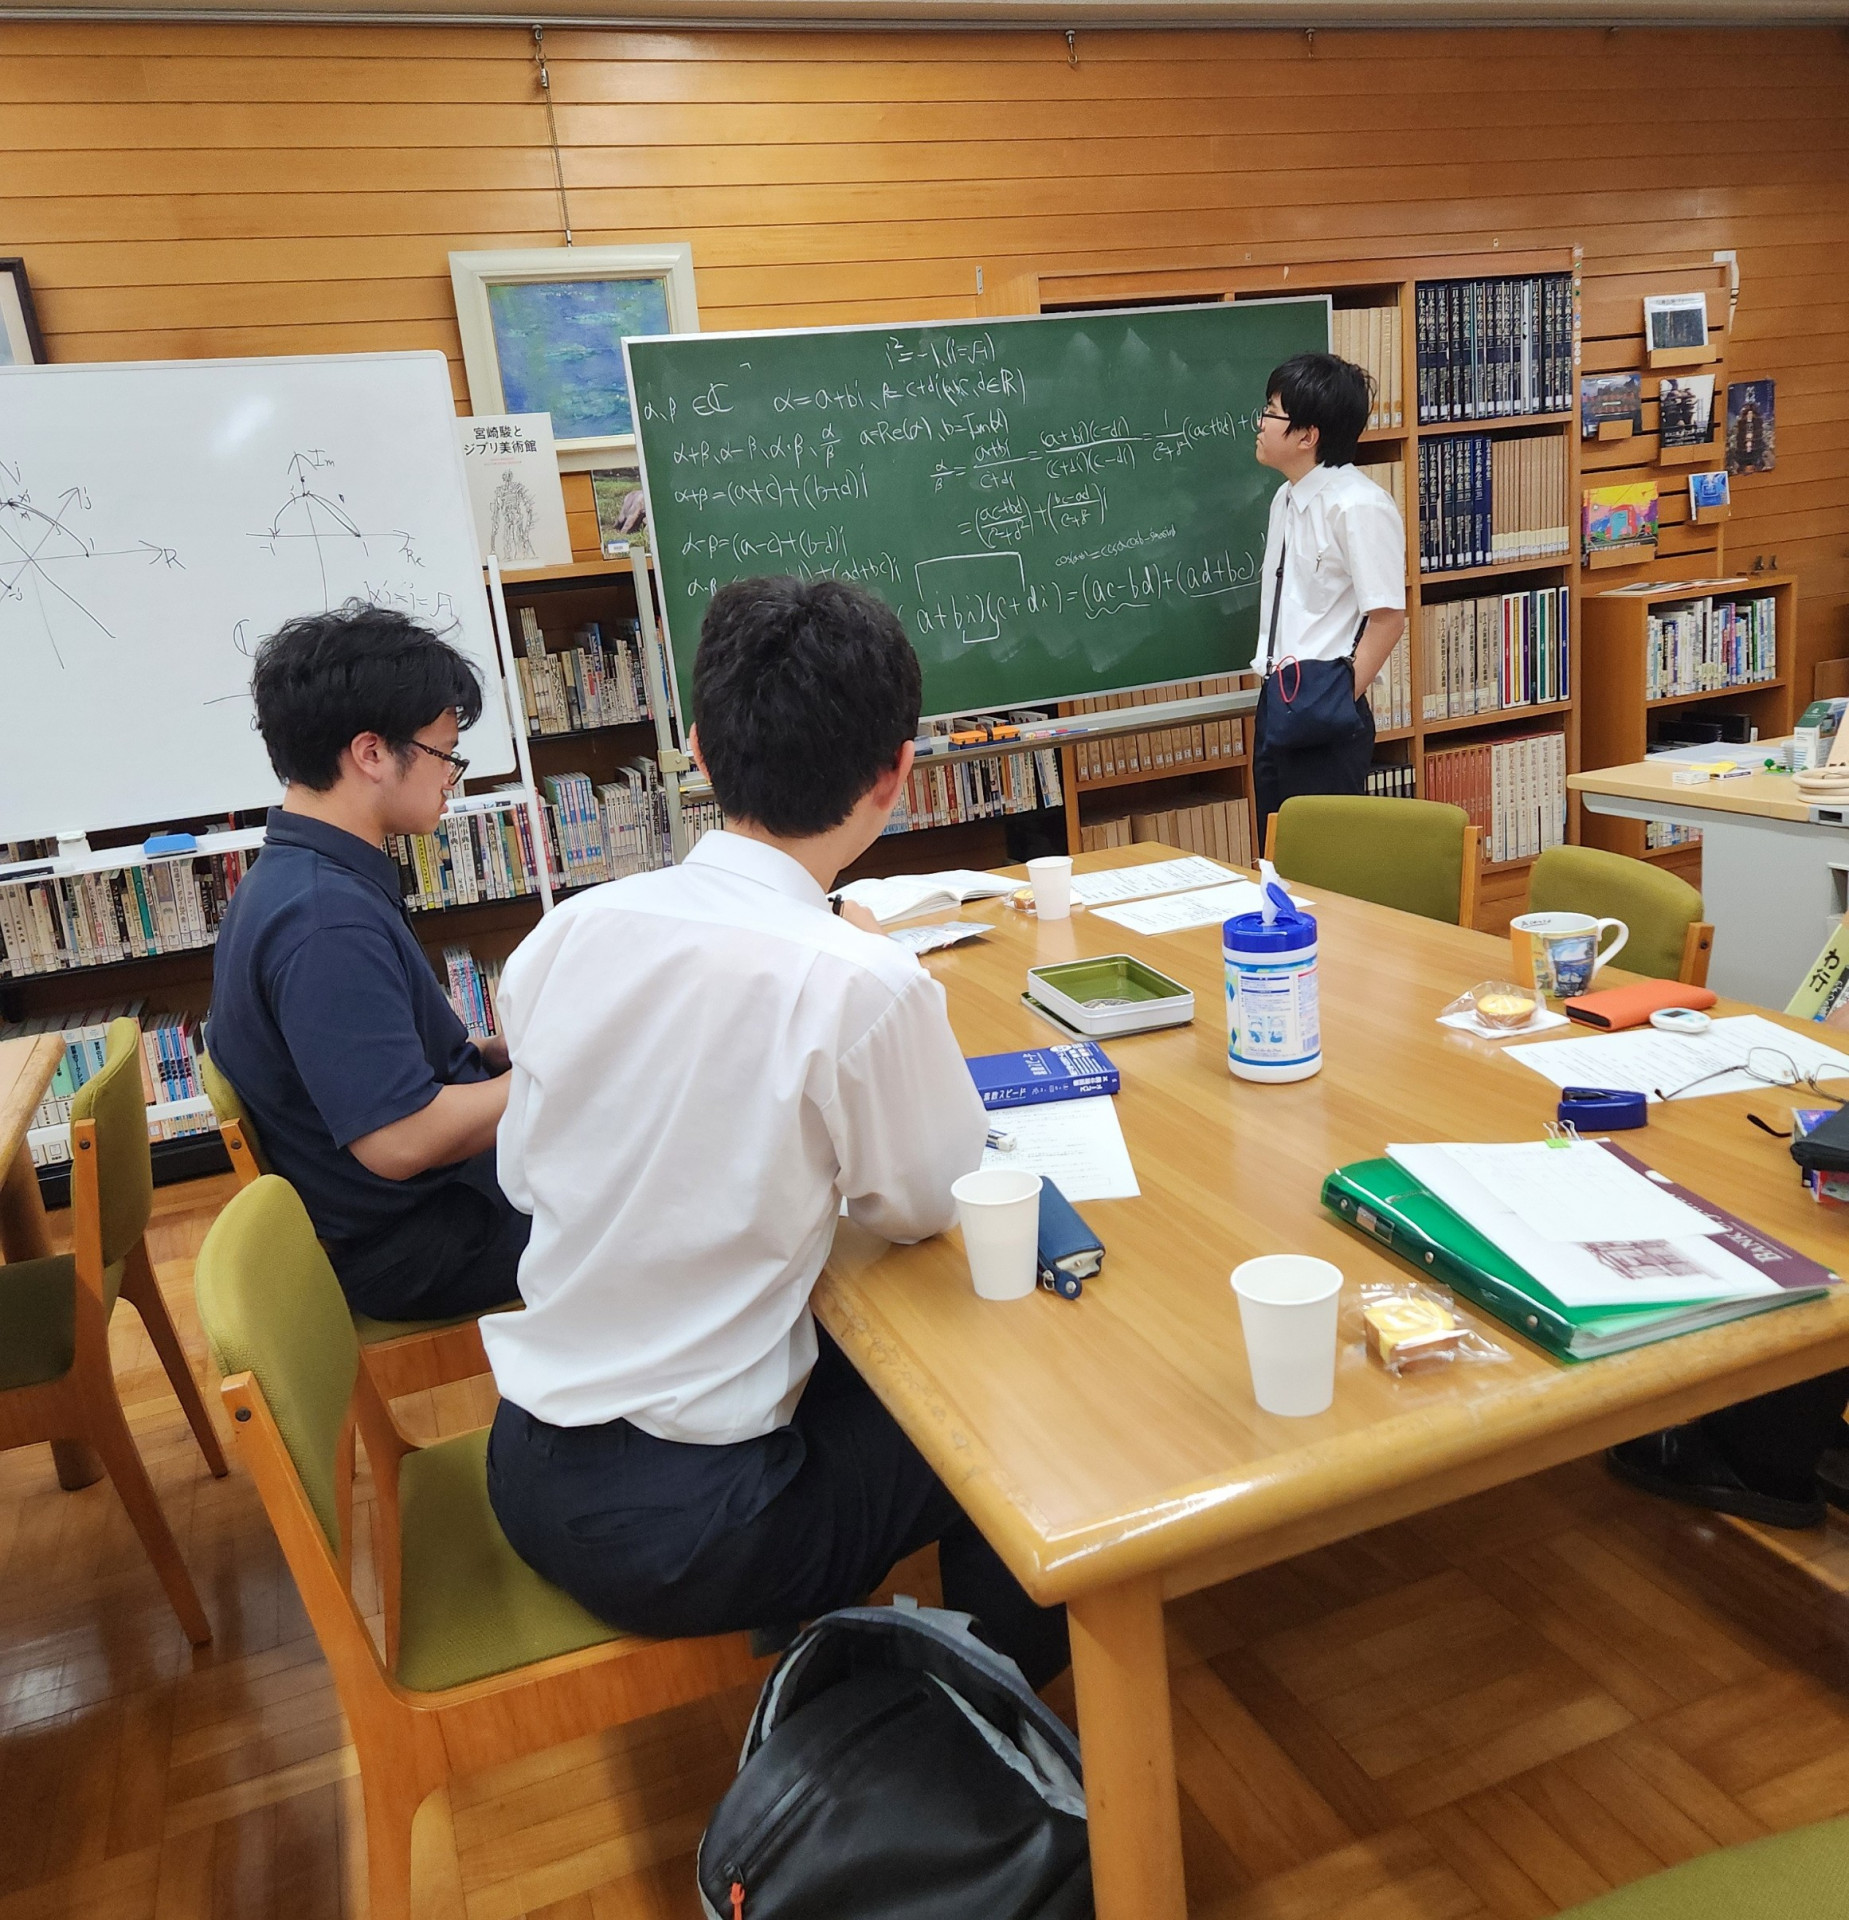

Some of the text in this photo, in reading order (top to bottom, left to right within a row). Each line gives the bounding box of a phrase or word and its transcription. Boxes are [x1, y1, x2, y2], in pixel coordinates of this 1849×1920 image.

[473, 425, 523, 440] 宮崎駿と
[464, 439, 538, 456] ジブリ美術館
[1809, 948, 1840, 993] わ行
